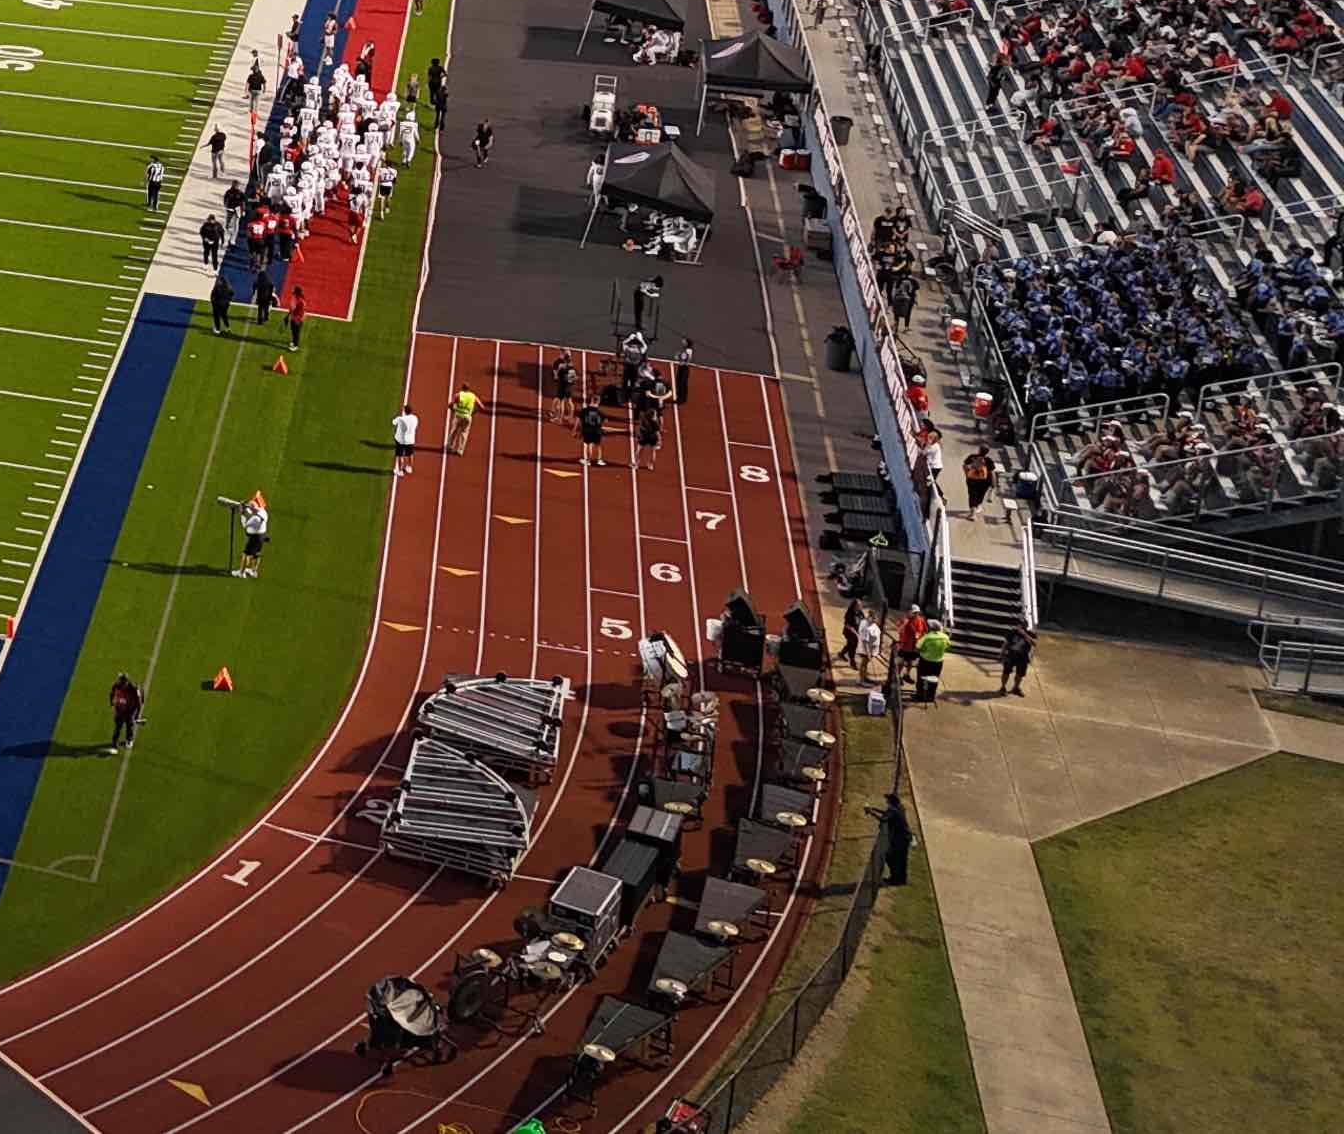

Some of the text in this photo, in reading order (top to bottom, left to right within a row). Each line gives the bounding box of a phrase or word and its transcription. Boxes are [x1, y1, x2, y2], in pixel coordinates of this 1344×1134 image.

[738, 464, 771, 484] 8
[695, 510, 728, 531] 7
[649, 561, 683, 584] 6
[599, 616, 634, 640] 5
[222, 858, 263, 886] 1
